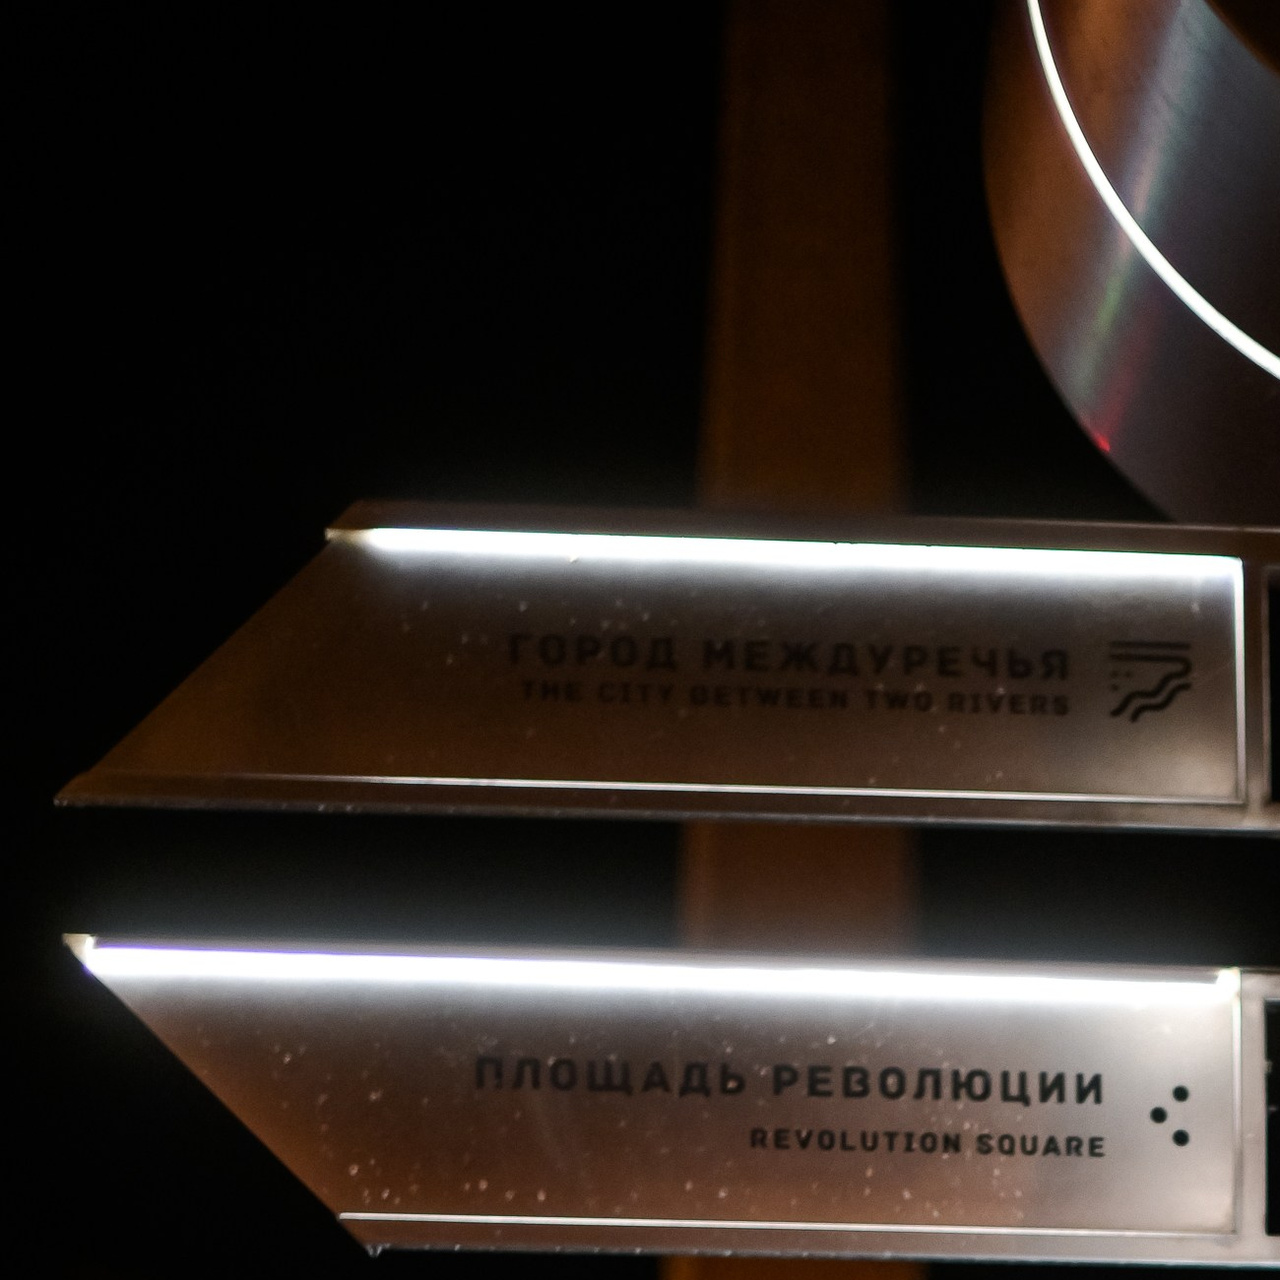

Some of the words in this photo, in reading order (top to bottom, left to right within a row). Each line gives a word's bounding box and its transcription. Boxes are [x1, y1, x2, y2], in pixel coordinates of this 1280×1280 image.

[508, 632, 678, 670] ГОРОД
[702, 640, 1070, 681] МЕЖДУРЕЧЬЯ
[522, 680, 582, 703] THE
[598, 683, 675, 705] CITY
[691, 686, 848, 710] BETWEEN
[865, 690, 932, 713] TWO
[948, 693, 1070, 716] RIVERS
[474, 1055, 747, 1099] ПЛОЩАДЬ
[774, 1063, 1105, 1106] РЕВОЛЮЦИИ
[750, 1126, 962, 1155] REVOLUTION
[975, 1132, 1106, 1159] SQUARE
